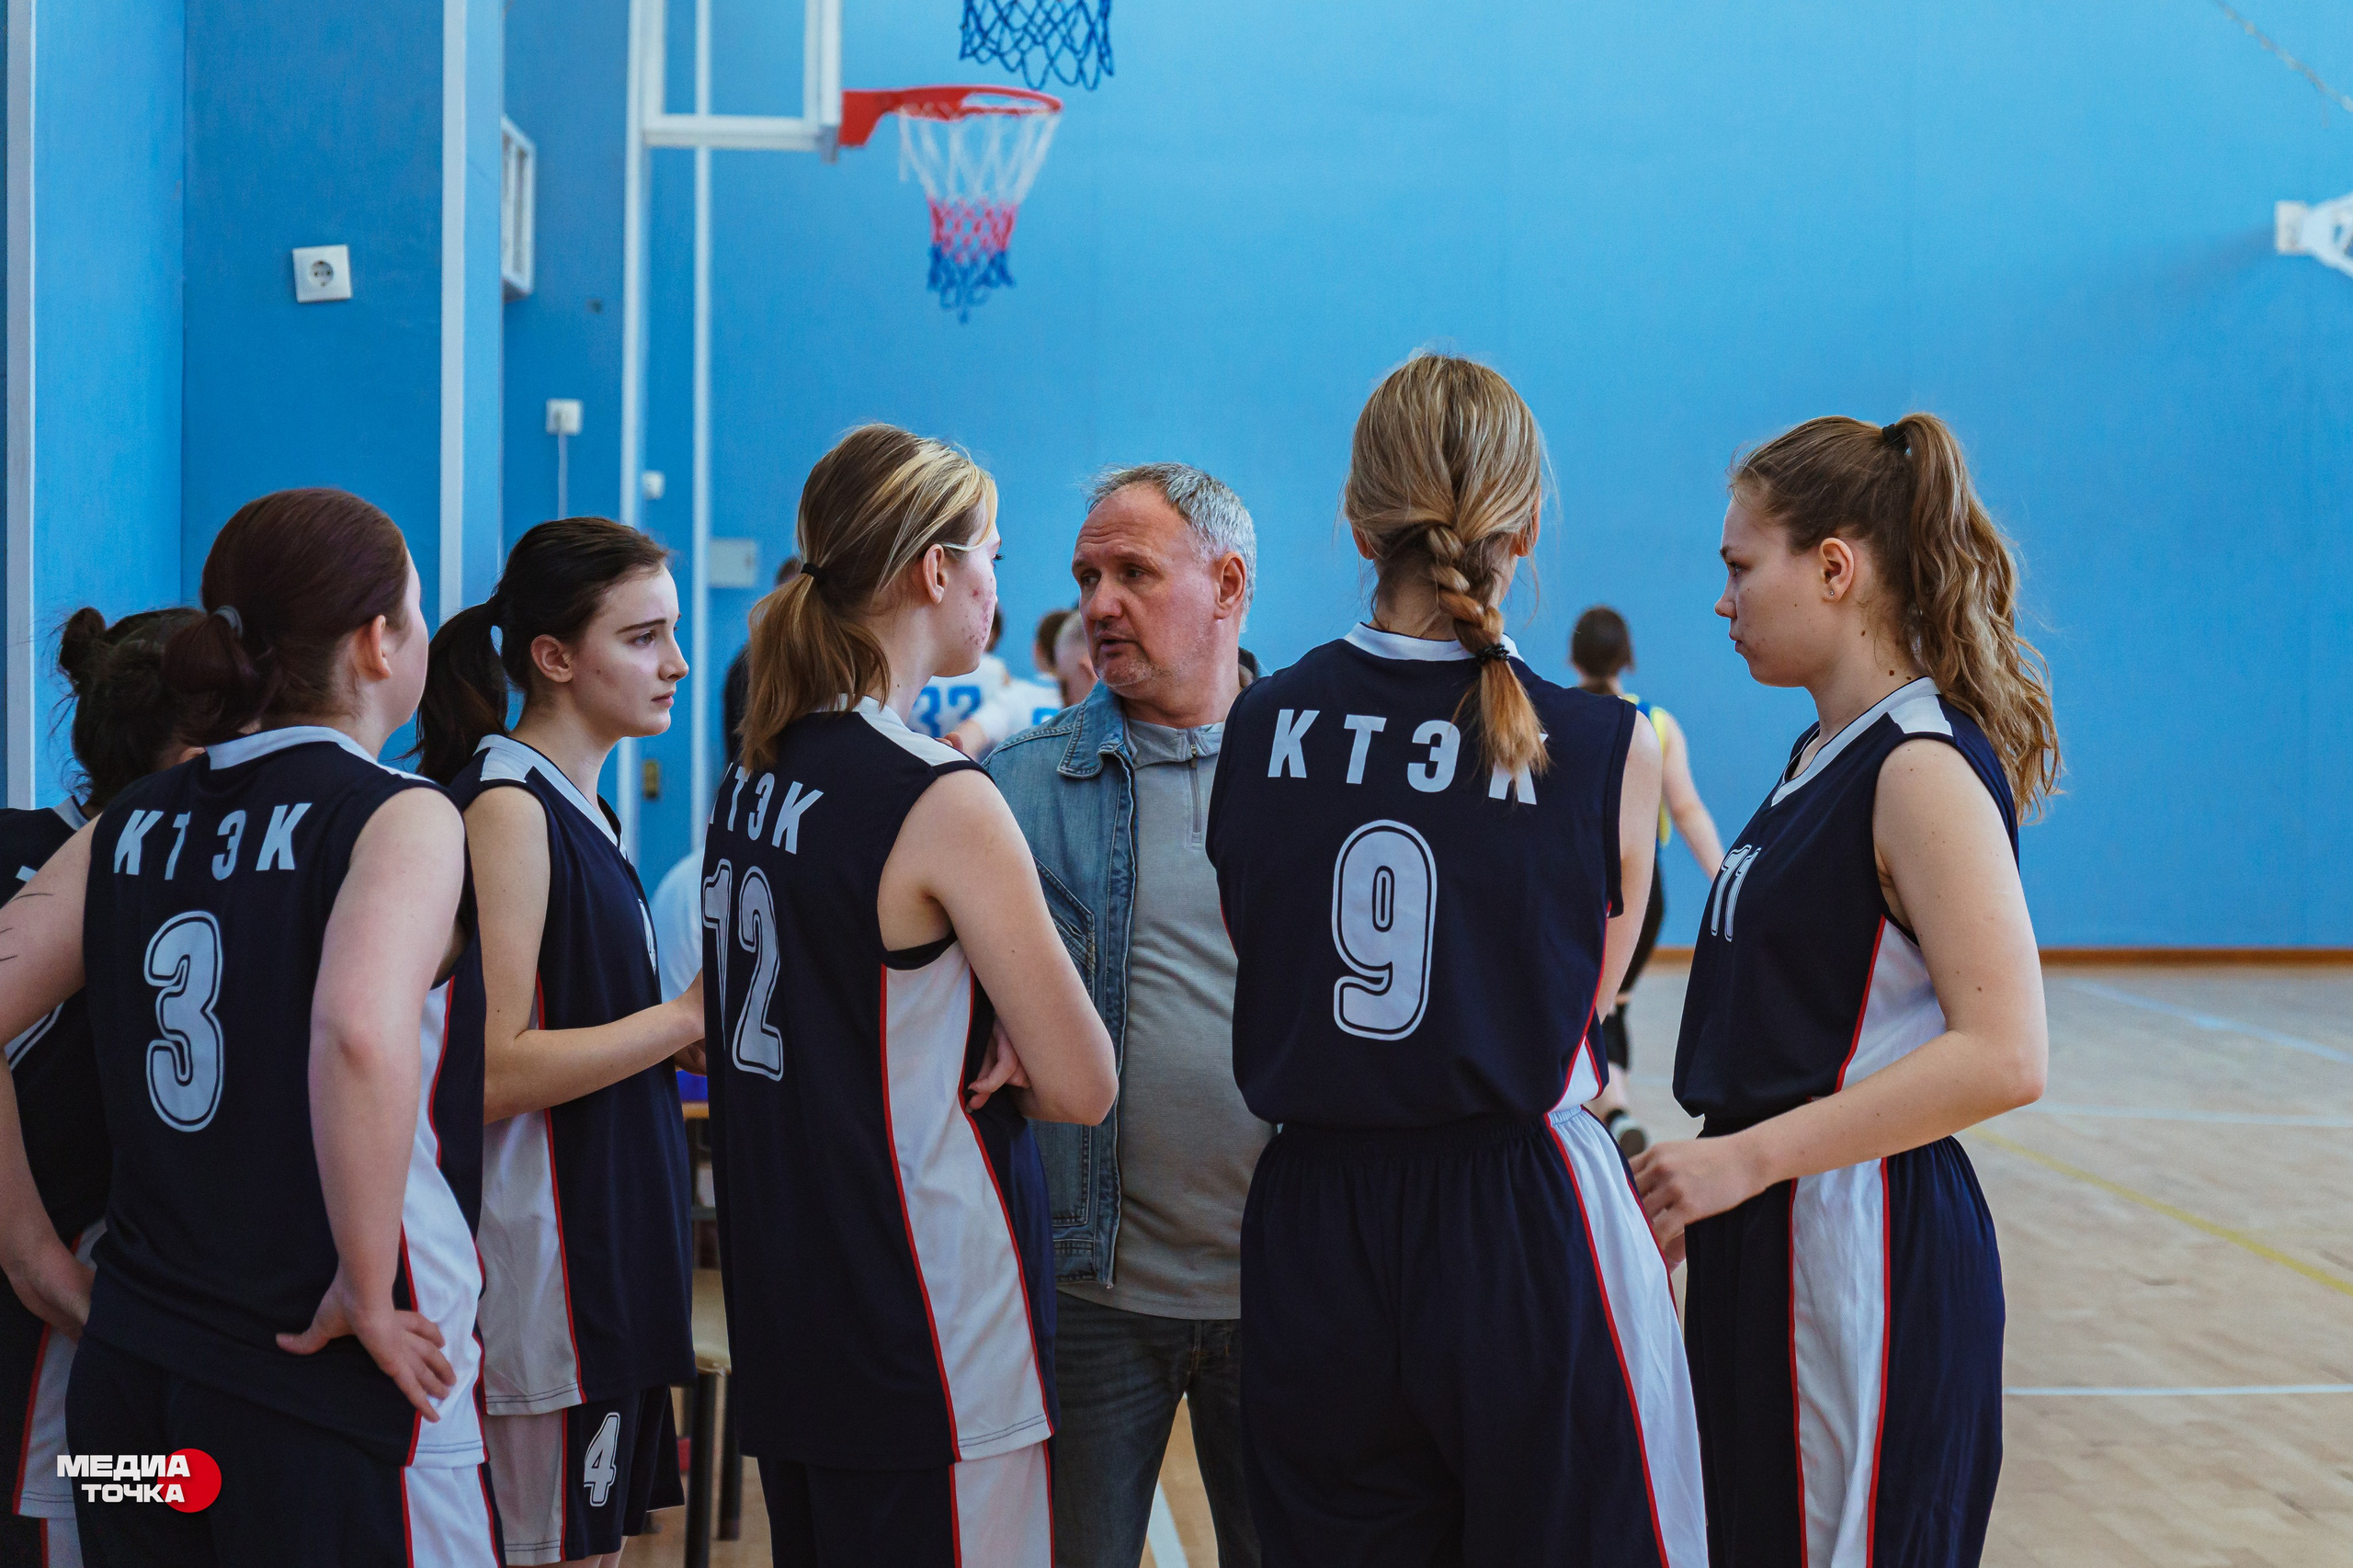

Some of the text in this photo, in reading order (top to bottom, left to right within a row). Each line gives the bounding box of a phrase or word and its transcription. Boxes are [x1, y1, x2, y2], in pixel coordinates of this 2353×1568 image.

[703, 858, 784, 1082] 12
[1332, 819, 1438, 1041] 9
[1711, 844, 1762, 942] 11
[144, 910, 223, 1132] 3
[584, 1412, 620, 1506] 4
